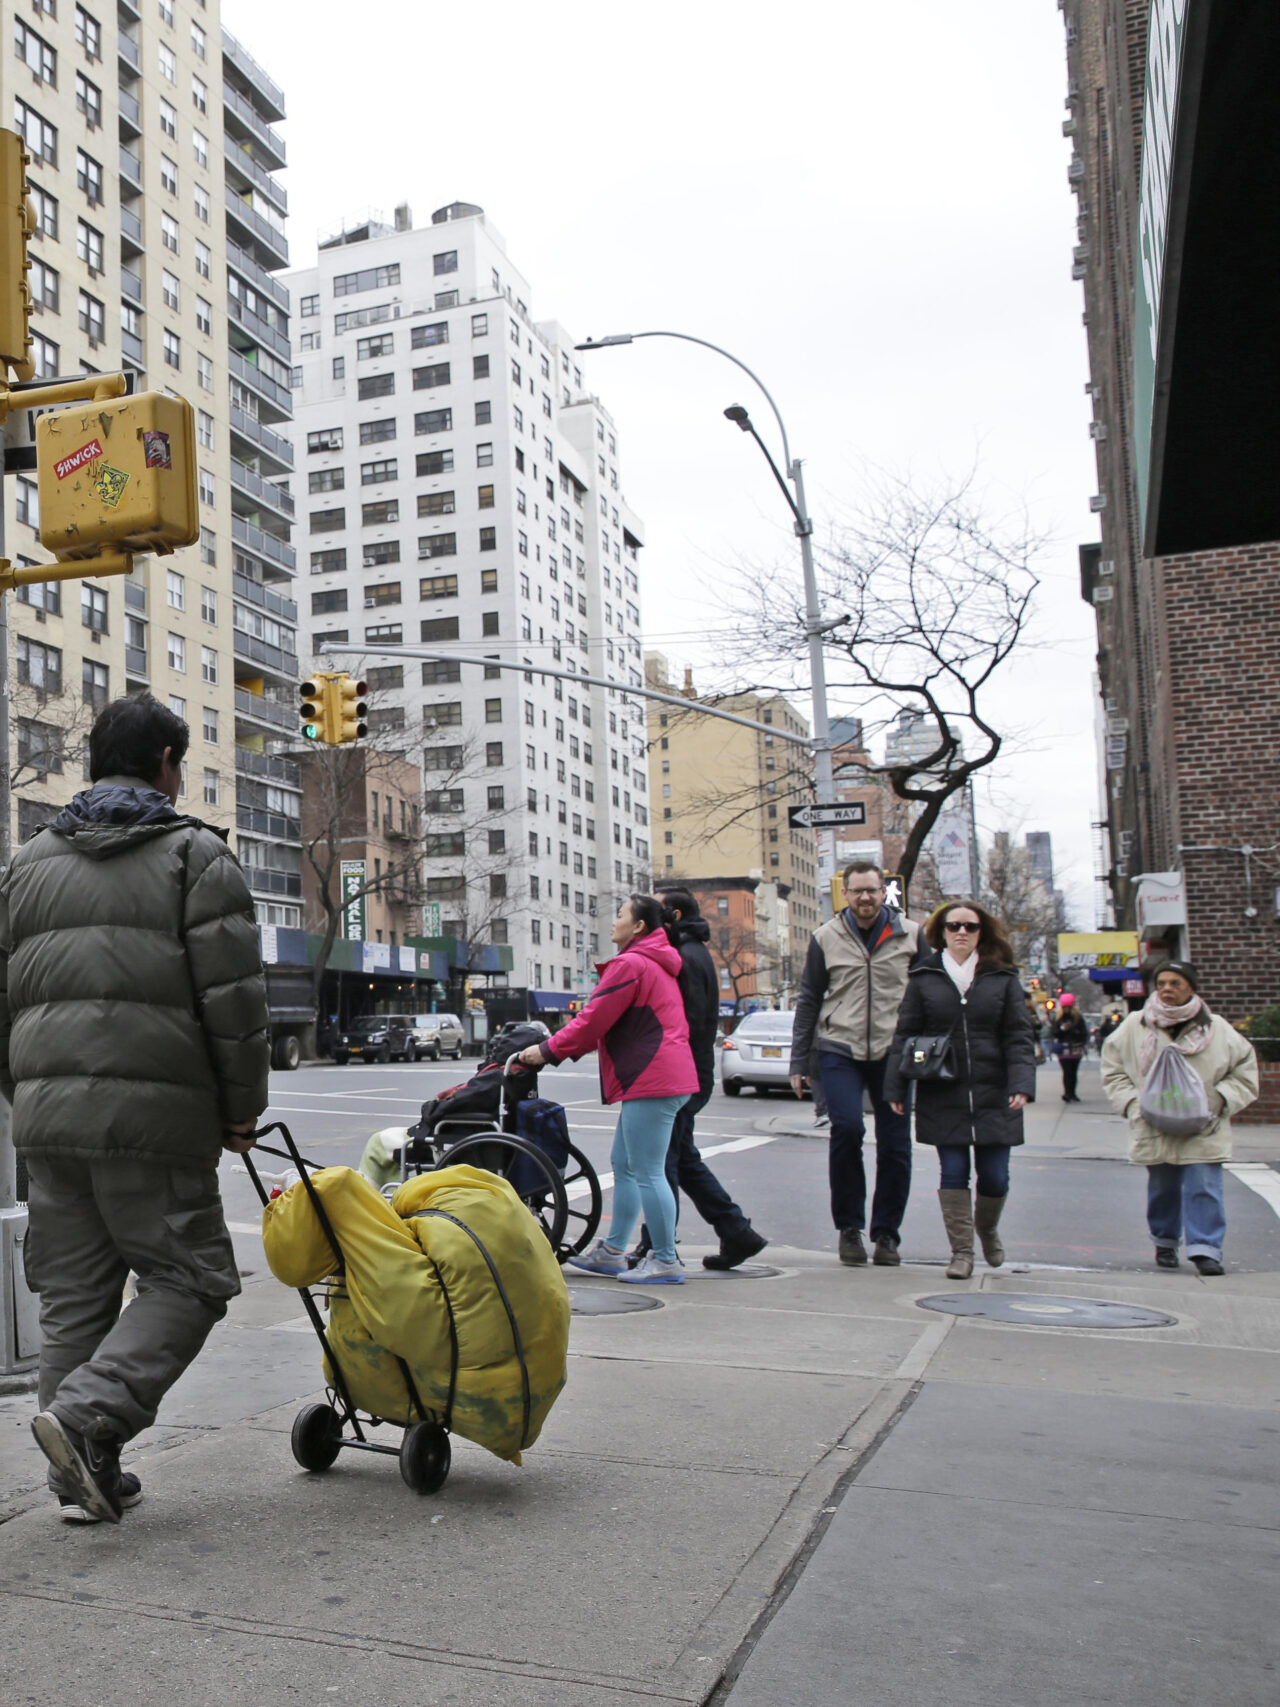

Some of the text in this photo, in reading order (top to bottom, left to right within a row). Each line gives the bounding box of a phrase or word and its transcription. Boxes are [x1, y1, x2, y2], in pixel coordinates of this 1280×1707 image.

[1140, 0, 1184, 362] STARB
[56, 443, 101, 477] SHWICK
[802, 809, 857, 821] ONE WAY
